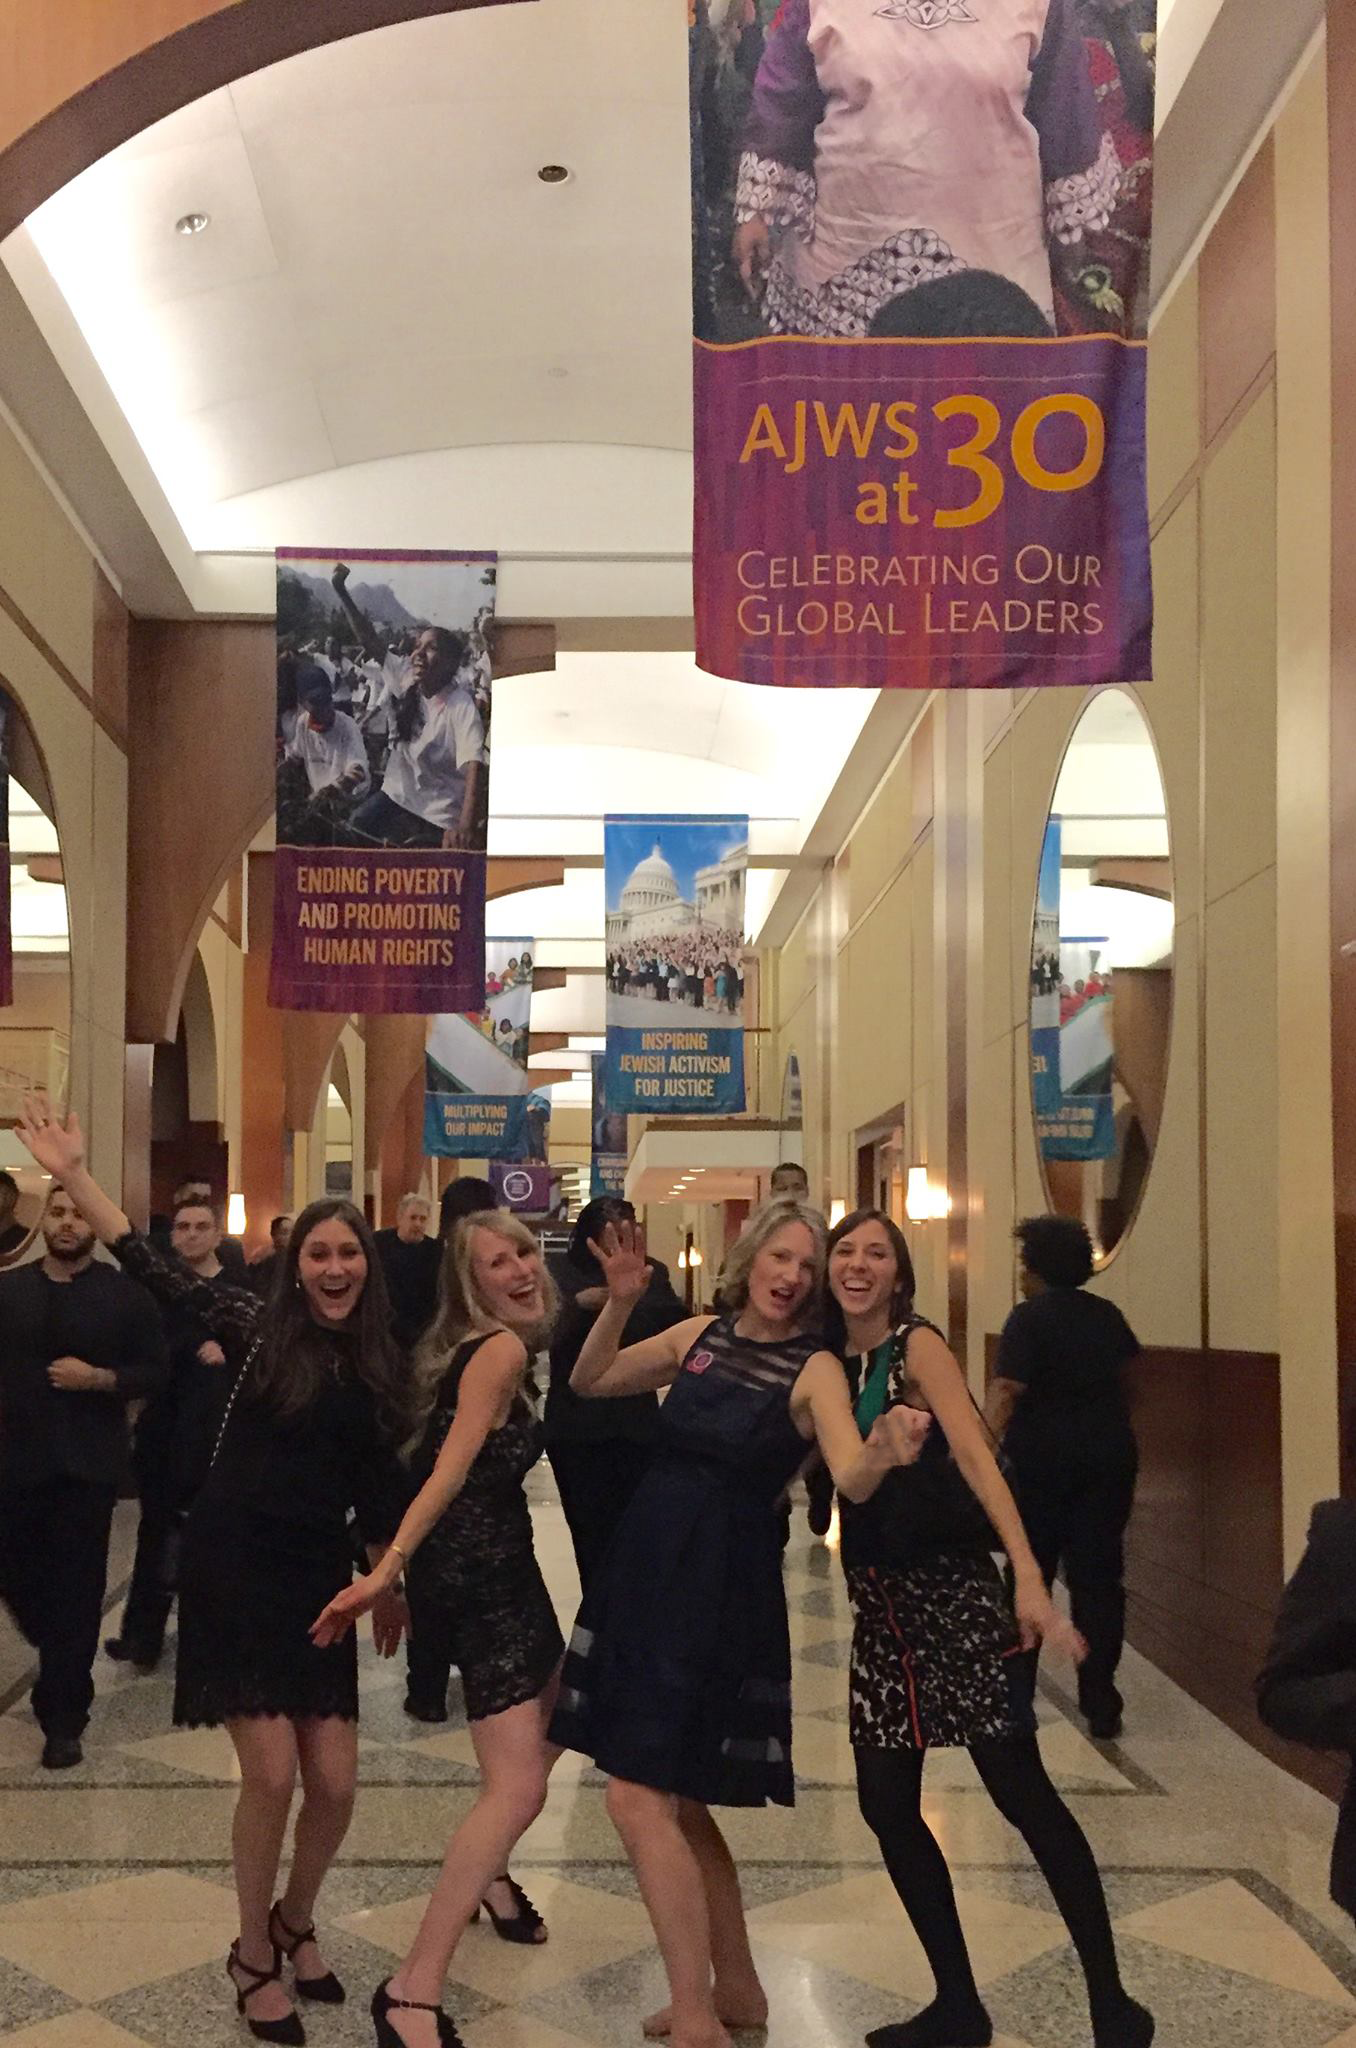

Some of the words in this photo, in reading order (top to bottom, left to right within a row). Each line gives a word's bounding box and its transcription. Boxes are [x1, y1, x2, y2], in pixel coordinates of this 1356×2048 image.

[739, 400, 919, 474] AJWS
[855, 471, 919, 526] at
[931, 393, 1106, 528] 30
[737, 550, 999, 590] CELEBRATING
[1015, 544, 1101, 588] OUR
[737, 595, 906, 637] GLOBAL
[924, 592, 1104, 635] LEADERS
[297, 866, 369, 894] ENDING
[374, 867, 465, 896] POVERTY
[298, 902, 338, 930] AND
[344, 902, 461, 931] PROMOTING
[303, 937, 376, 965] HUMAN
[381, 938, 454, 967] RIGHTS
[641, 1032, 708, 1050] INSPIRING
[620, 1055, 665, 1073] JEWISH
[669, 1056, 731, 1073] ACTIVISM
[635, 1079, 660, 1096] FOR
[663, 1079, 714, 1096] JUSTICE
[444, 1104, 508, 1119] MULTIPLYING
[445, 1122, 466, 1136] OUR
[468, 1122, 505, 1137] IMPACT
